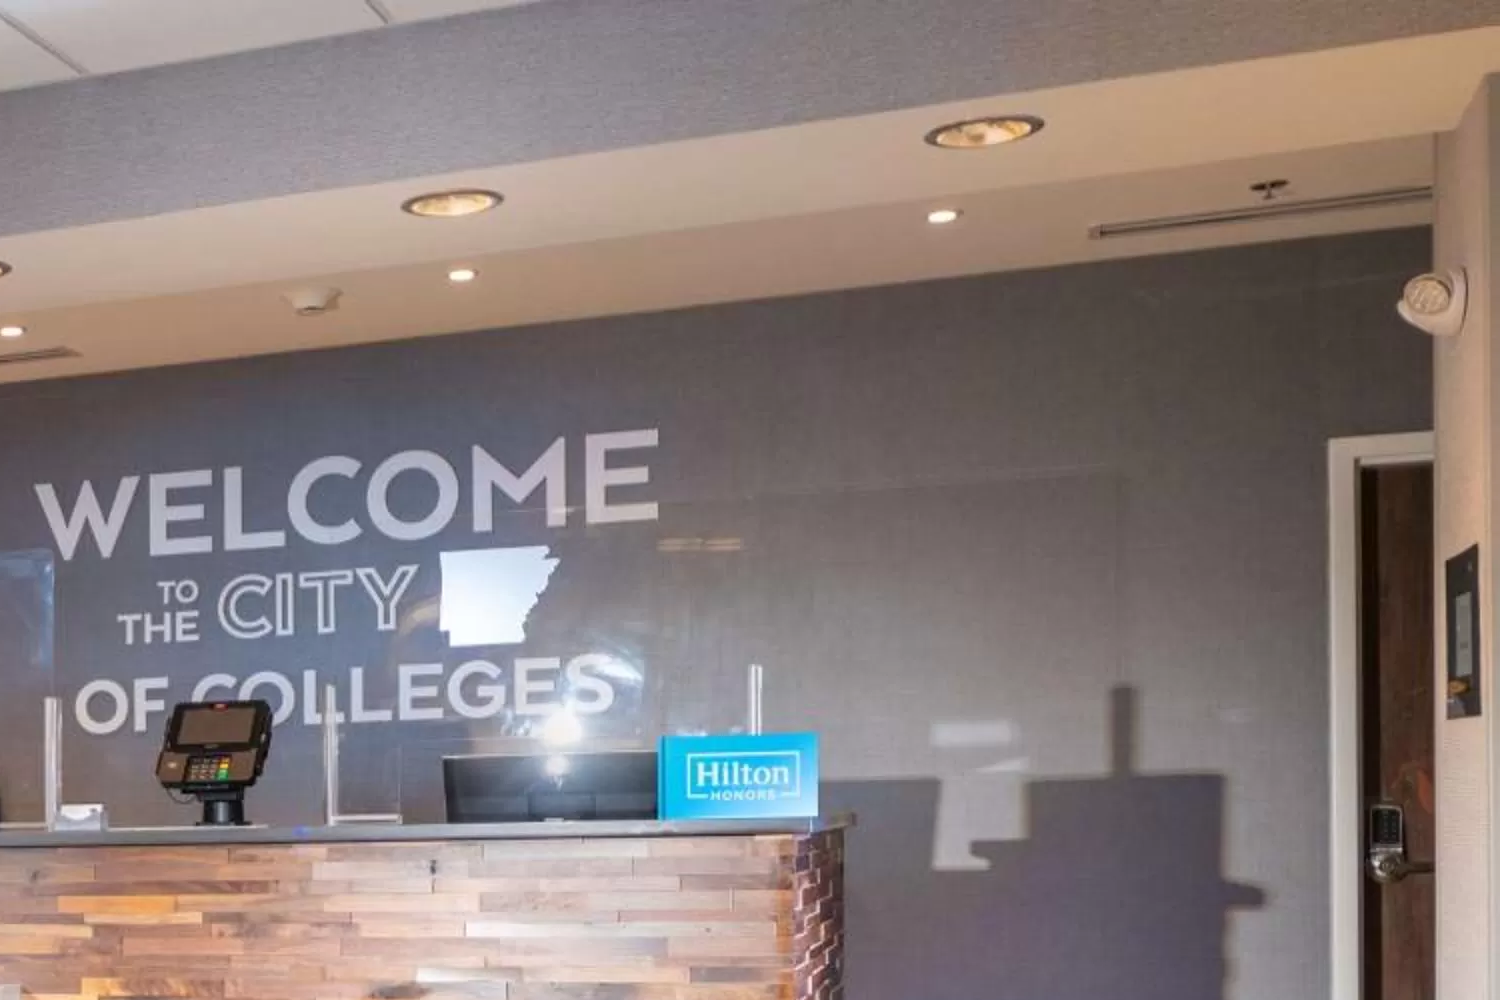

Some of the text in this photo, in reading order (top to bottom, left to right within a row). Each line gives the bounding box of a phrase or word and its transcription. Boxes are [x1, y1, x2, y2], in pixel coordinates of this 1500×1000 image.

[34, 428, 659, 561] WELCOME
[157, 578, 199, 604] TO
[217, 563, 420, 638] CITY
[117, 609, 200, 646] THE
[75, 675, 169, 735] OF
[696, 761, 789, 787] Hilton
[711, 788, 776, 801] HONORS
